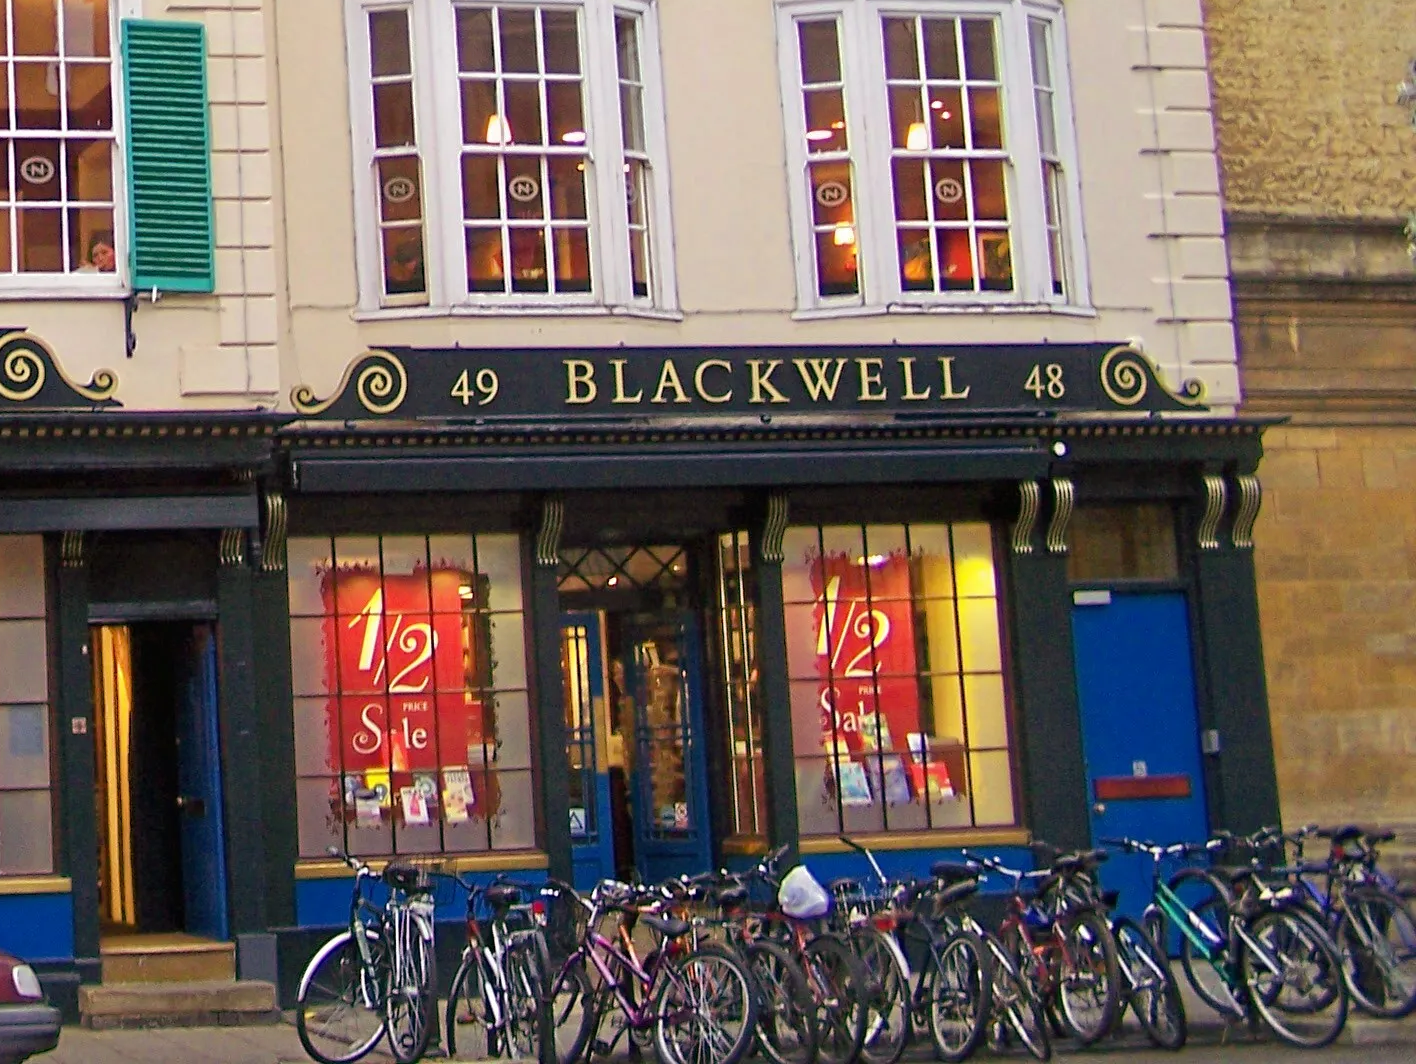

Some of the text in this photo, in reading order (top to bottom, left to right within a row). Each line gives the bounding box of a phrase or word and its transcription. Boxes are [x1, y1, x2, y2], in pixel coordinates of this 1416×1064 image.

[450, 356, 1065, 406] 49 BLACKWELL 48
[348, 588, 439, 693] 1/2
[353, 703, 428, 754] Sle
[402, 701, 428, 712] PRICE
